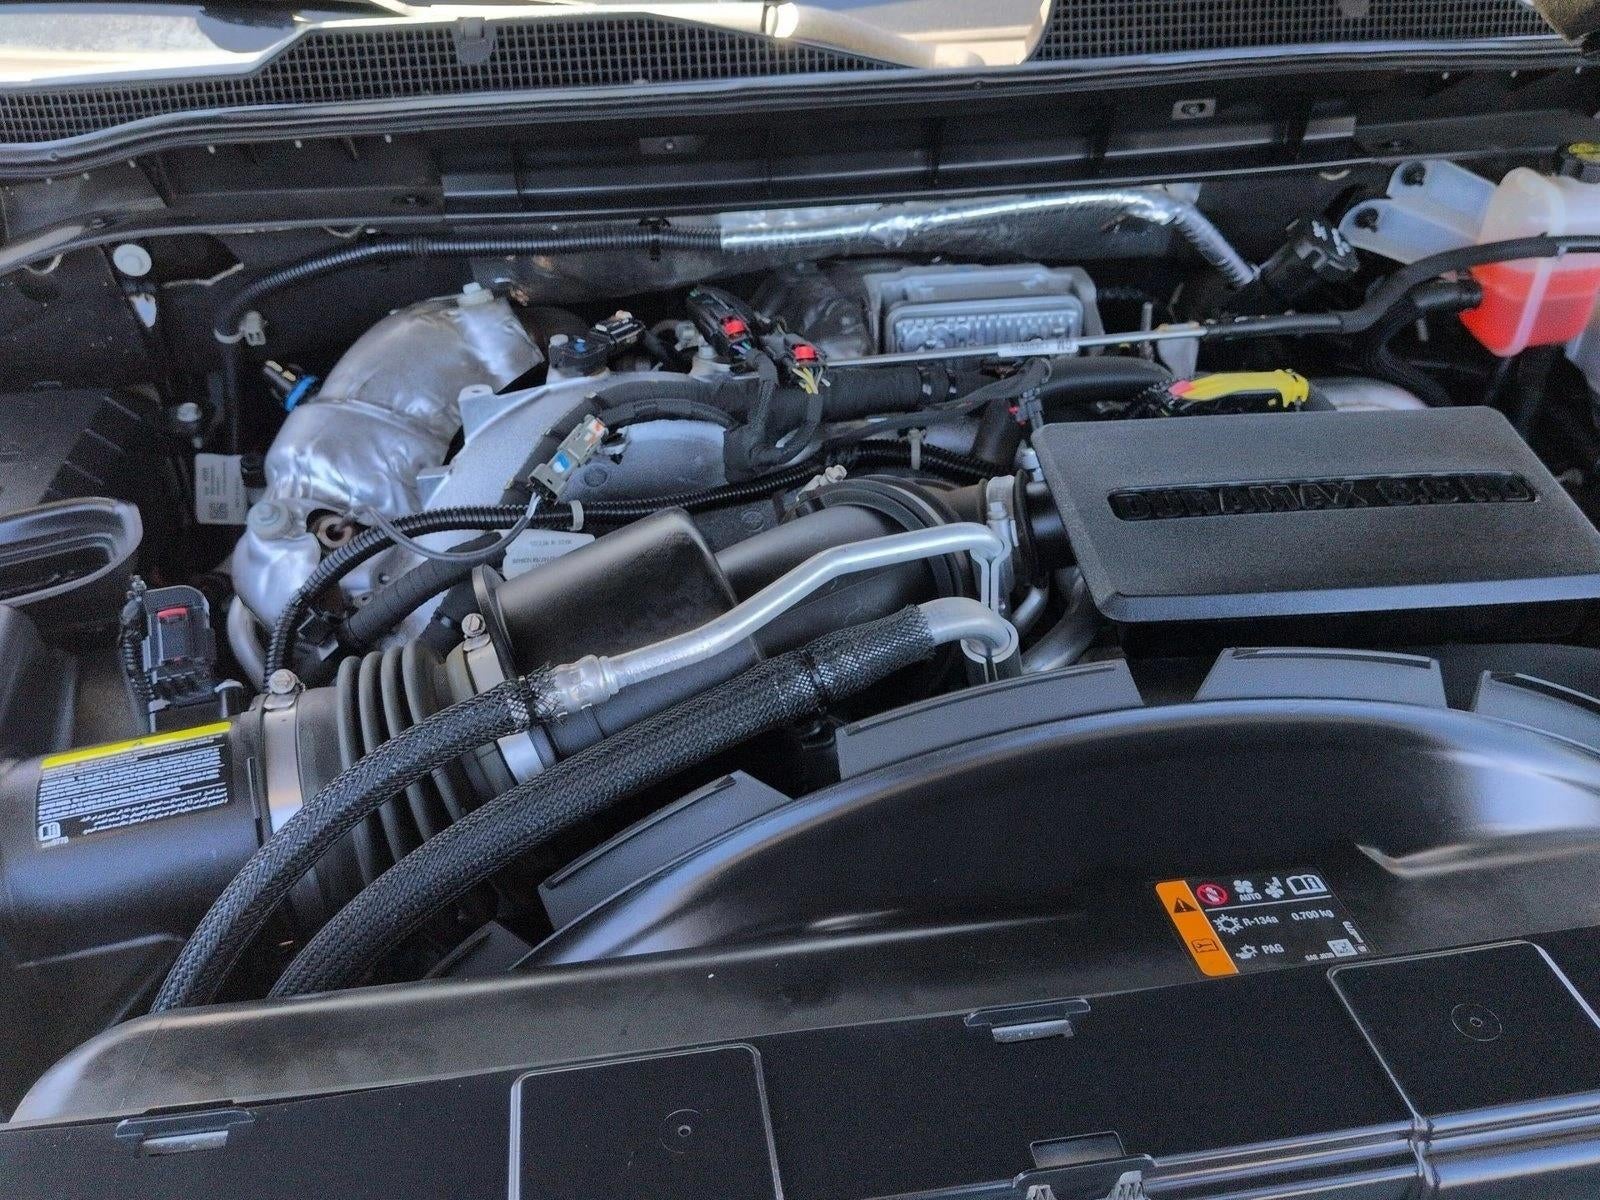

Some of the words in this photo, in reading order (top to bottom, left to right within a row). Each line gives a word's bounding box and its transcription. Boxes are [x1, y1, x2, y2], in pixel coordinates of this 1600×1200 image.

[1113, 481, 1369, 520] DURAMAX
[1239, 892, 1263, 902] AUTO
[1242, 915, 1279, 927] R-134a
[1290, 909, 1318, 921] 0.700
[1318, 908, 1335, 919] kg
[1261, 943, 1285, 955] PAG
